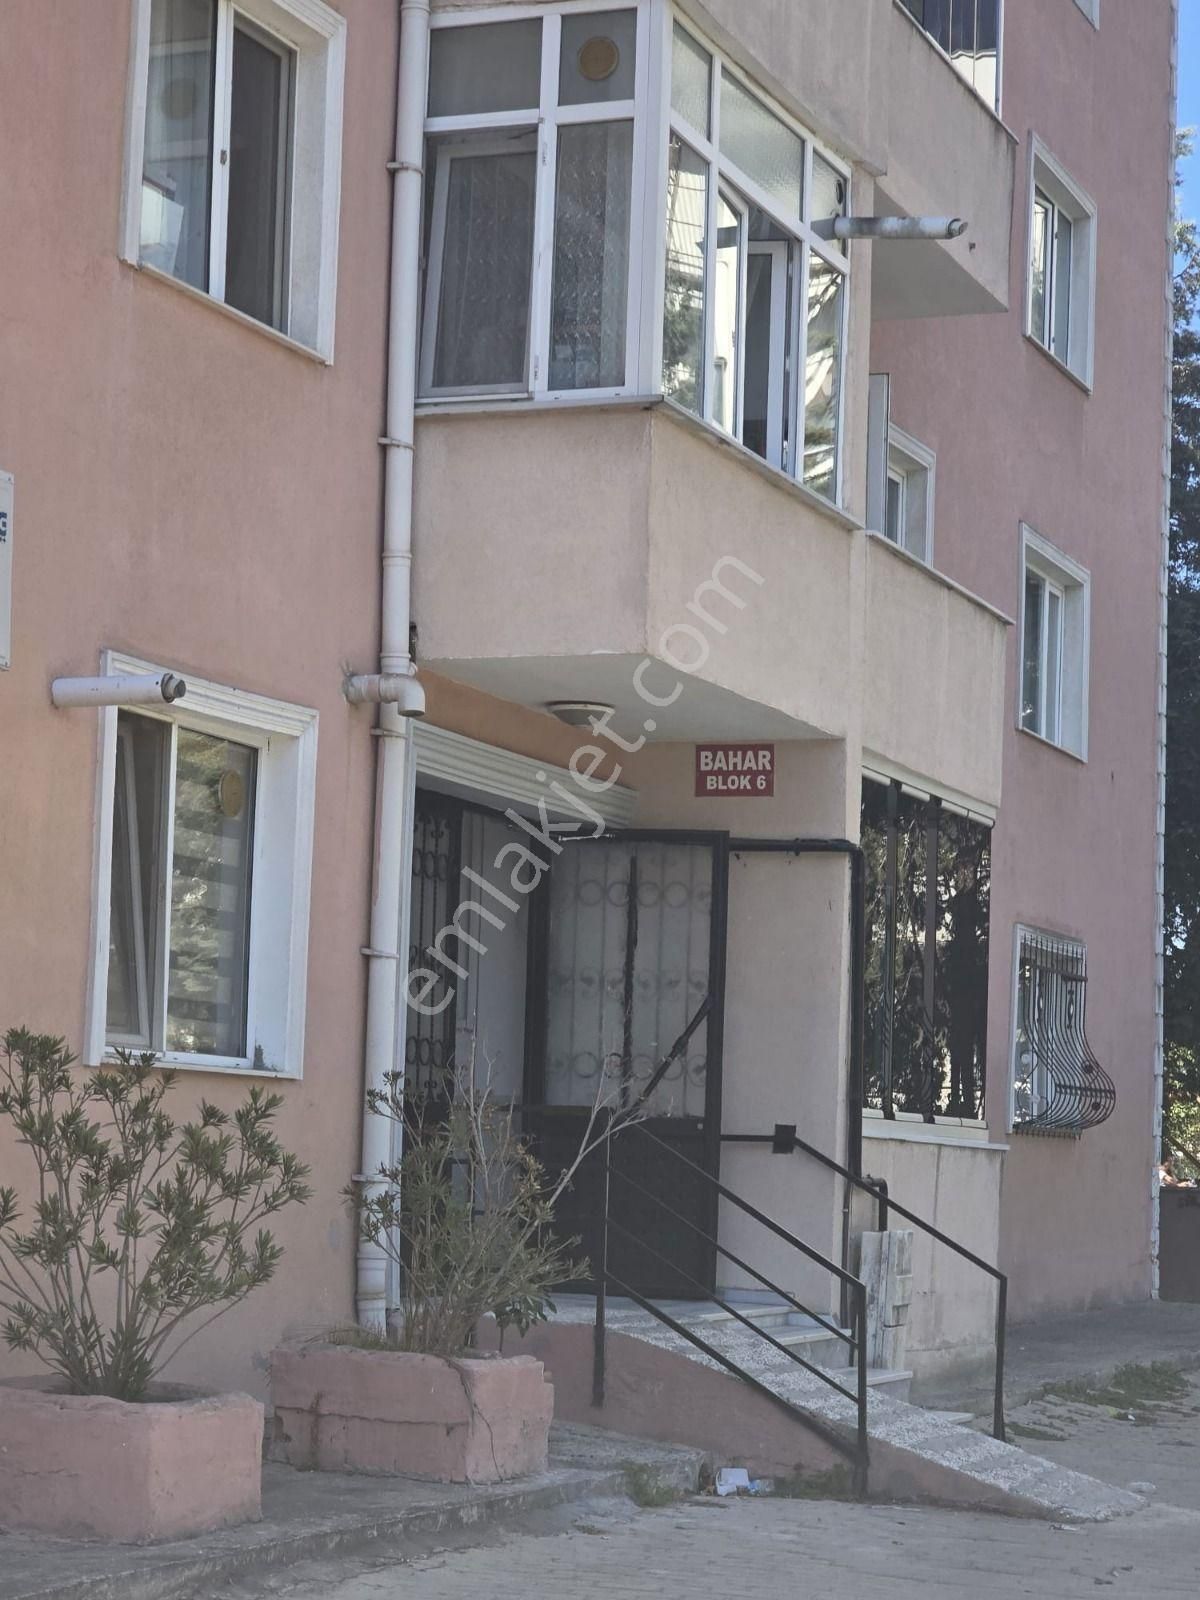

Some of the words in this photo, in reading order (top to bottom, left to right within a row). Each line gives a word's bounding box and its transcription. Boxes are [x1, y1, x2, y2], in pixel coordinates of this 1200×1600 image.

[700, 750, 772, 771] BAHAR
[706, 775, 752, 790] BLOK
[756, 775, 766, 790] 6
